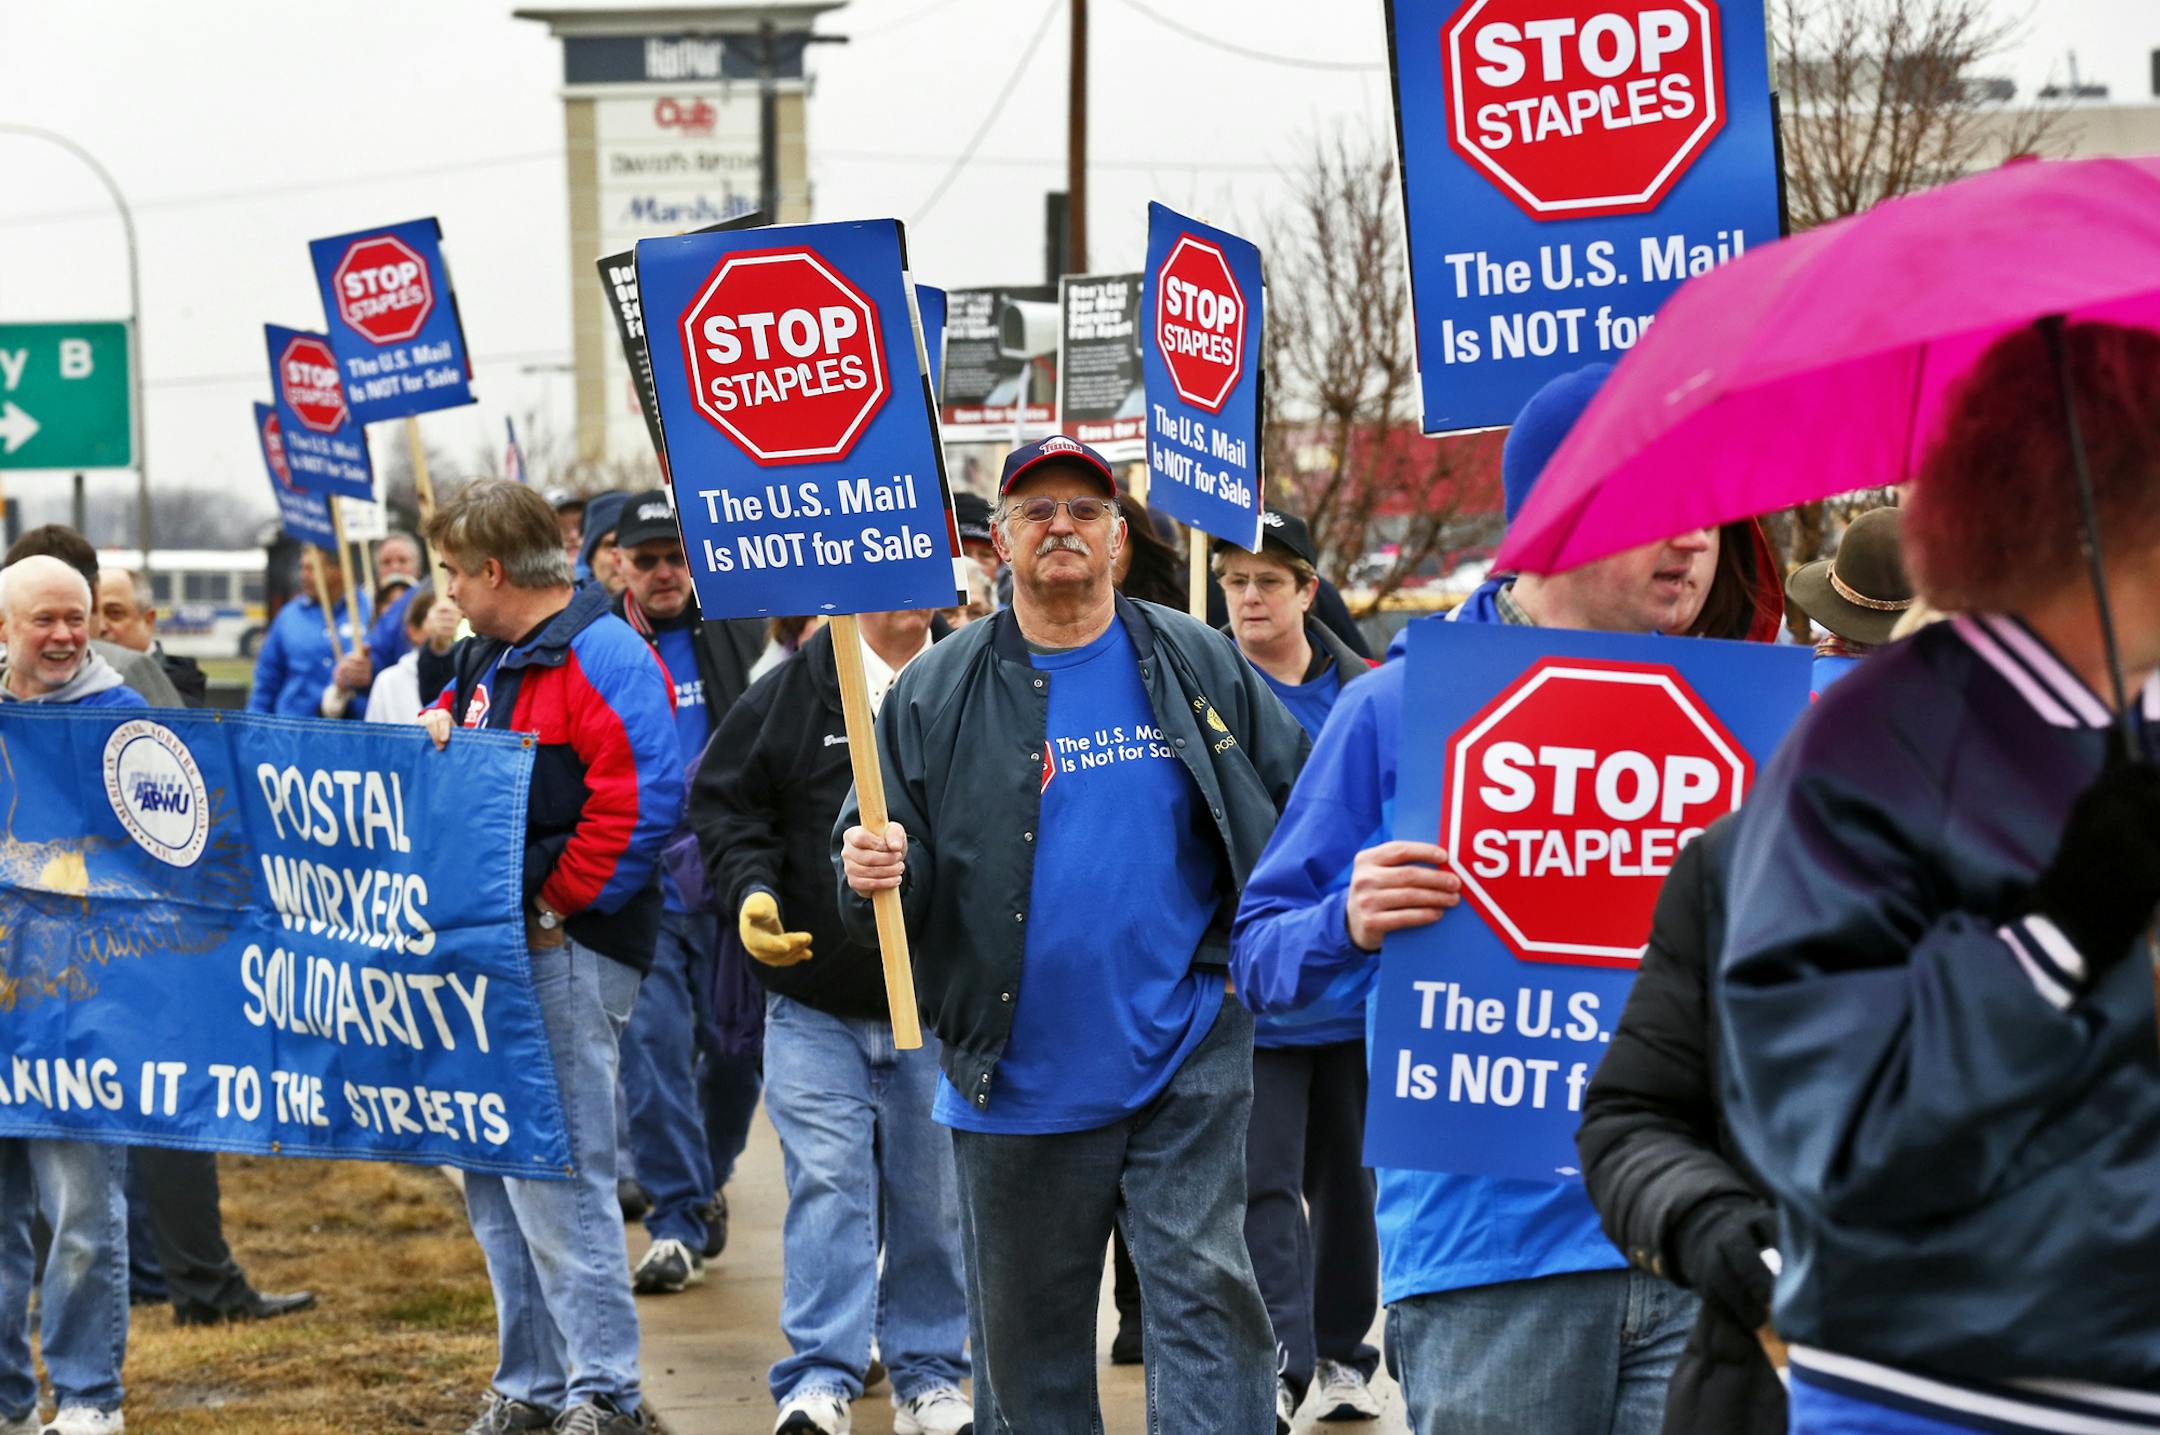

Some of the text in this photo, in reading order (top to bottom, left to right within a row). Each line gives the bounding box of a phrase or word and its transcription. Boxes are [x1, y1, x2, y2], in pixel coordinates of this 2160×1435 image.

[1475, 9, 1690, 88] STOP
[1477, 73, 1696, 150] STAPLES
[344, 261, 418, 298] STOP
[1445, 229, 1745, 298] The U.S. Mail
[348, 285, 424, 323] STAPLES
[1165, 275, 1237, 334] STOP
[59, 338, 94, 380] B
[347, 341, 453, 378] The U.S. Mail
[704, 305, 858, 365] STOP
[1164, 321, 1233, 367] STAPLES
[1443, 319, 1481, 364] Is
[1490, 308, 1587, 360] NOT
[287, 360, 340, 389] STOP
[348, 367, 460, 403] Is NOT for Sale
[710, 355, 868, 412] STAPLES
[1153, 404, 1178, 441] The
[1178, 415, 1209, 454] U.S.
[1211, 428, 1247, 469] Mail
[698, 489, 764, 524] The
[766, 482, 832, 519] U.S.
[837, 474, 917, 515] Mail
[1152, 442, 1251, 510] Is NOT for Sale
[703, 525, 933, 572] Is NOT for Sale
[1056, 724, 1165, 754] The U.S. Ma
[1061, 757, 1076, 773] Is
[1081, 747, 1115, 770] Not
[1118, 744, 1144, 763] for
[140, 790, 190, 815] APWU
[257, 763, 411, 853] POSTAL
[1479, 741, 1720, 823] STOP
[261, 853, 436, 956] WORKERS
[240, 943, 490, 1054] SOLIDARITY
[1413, 980, 1611, 1043] The U.S.
[0, 1055, 511, 1146] KING IT TO THE STREETS
[1395, 1048, 1438, 1101] Is
[1448, 1052, 1560, 1109] NOT
